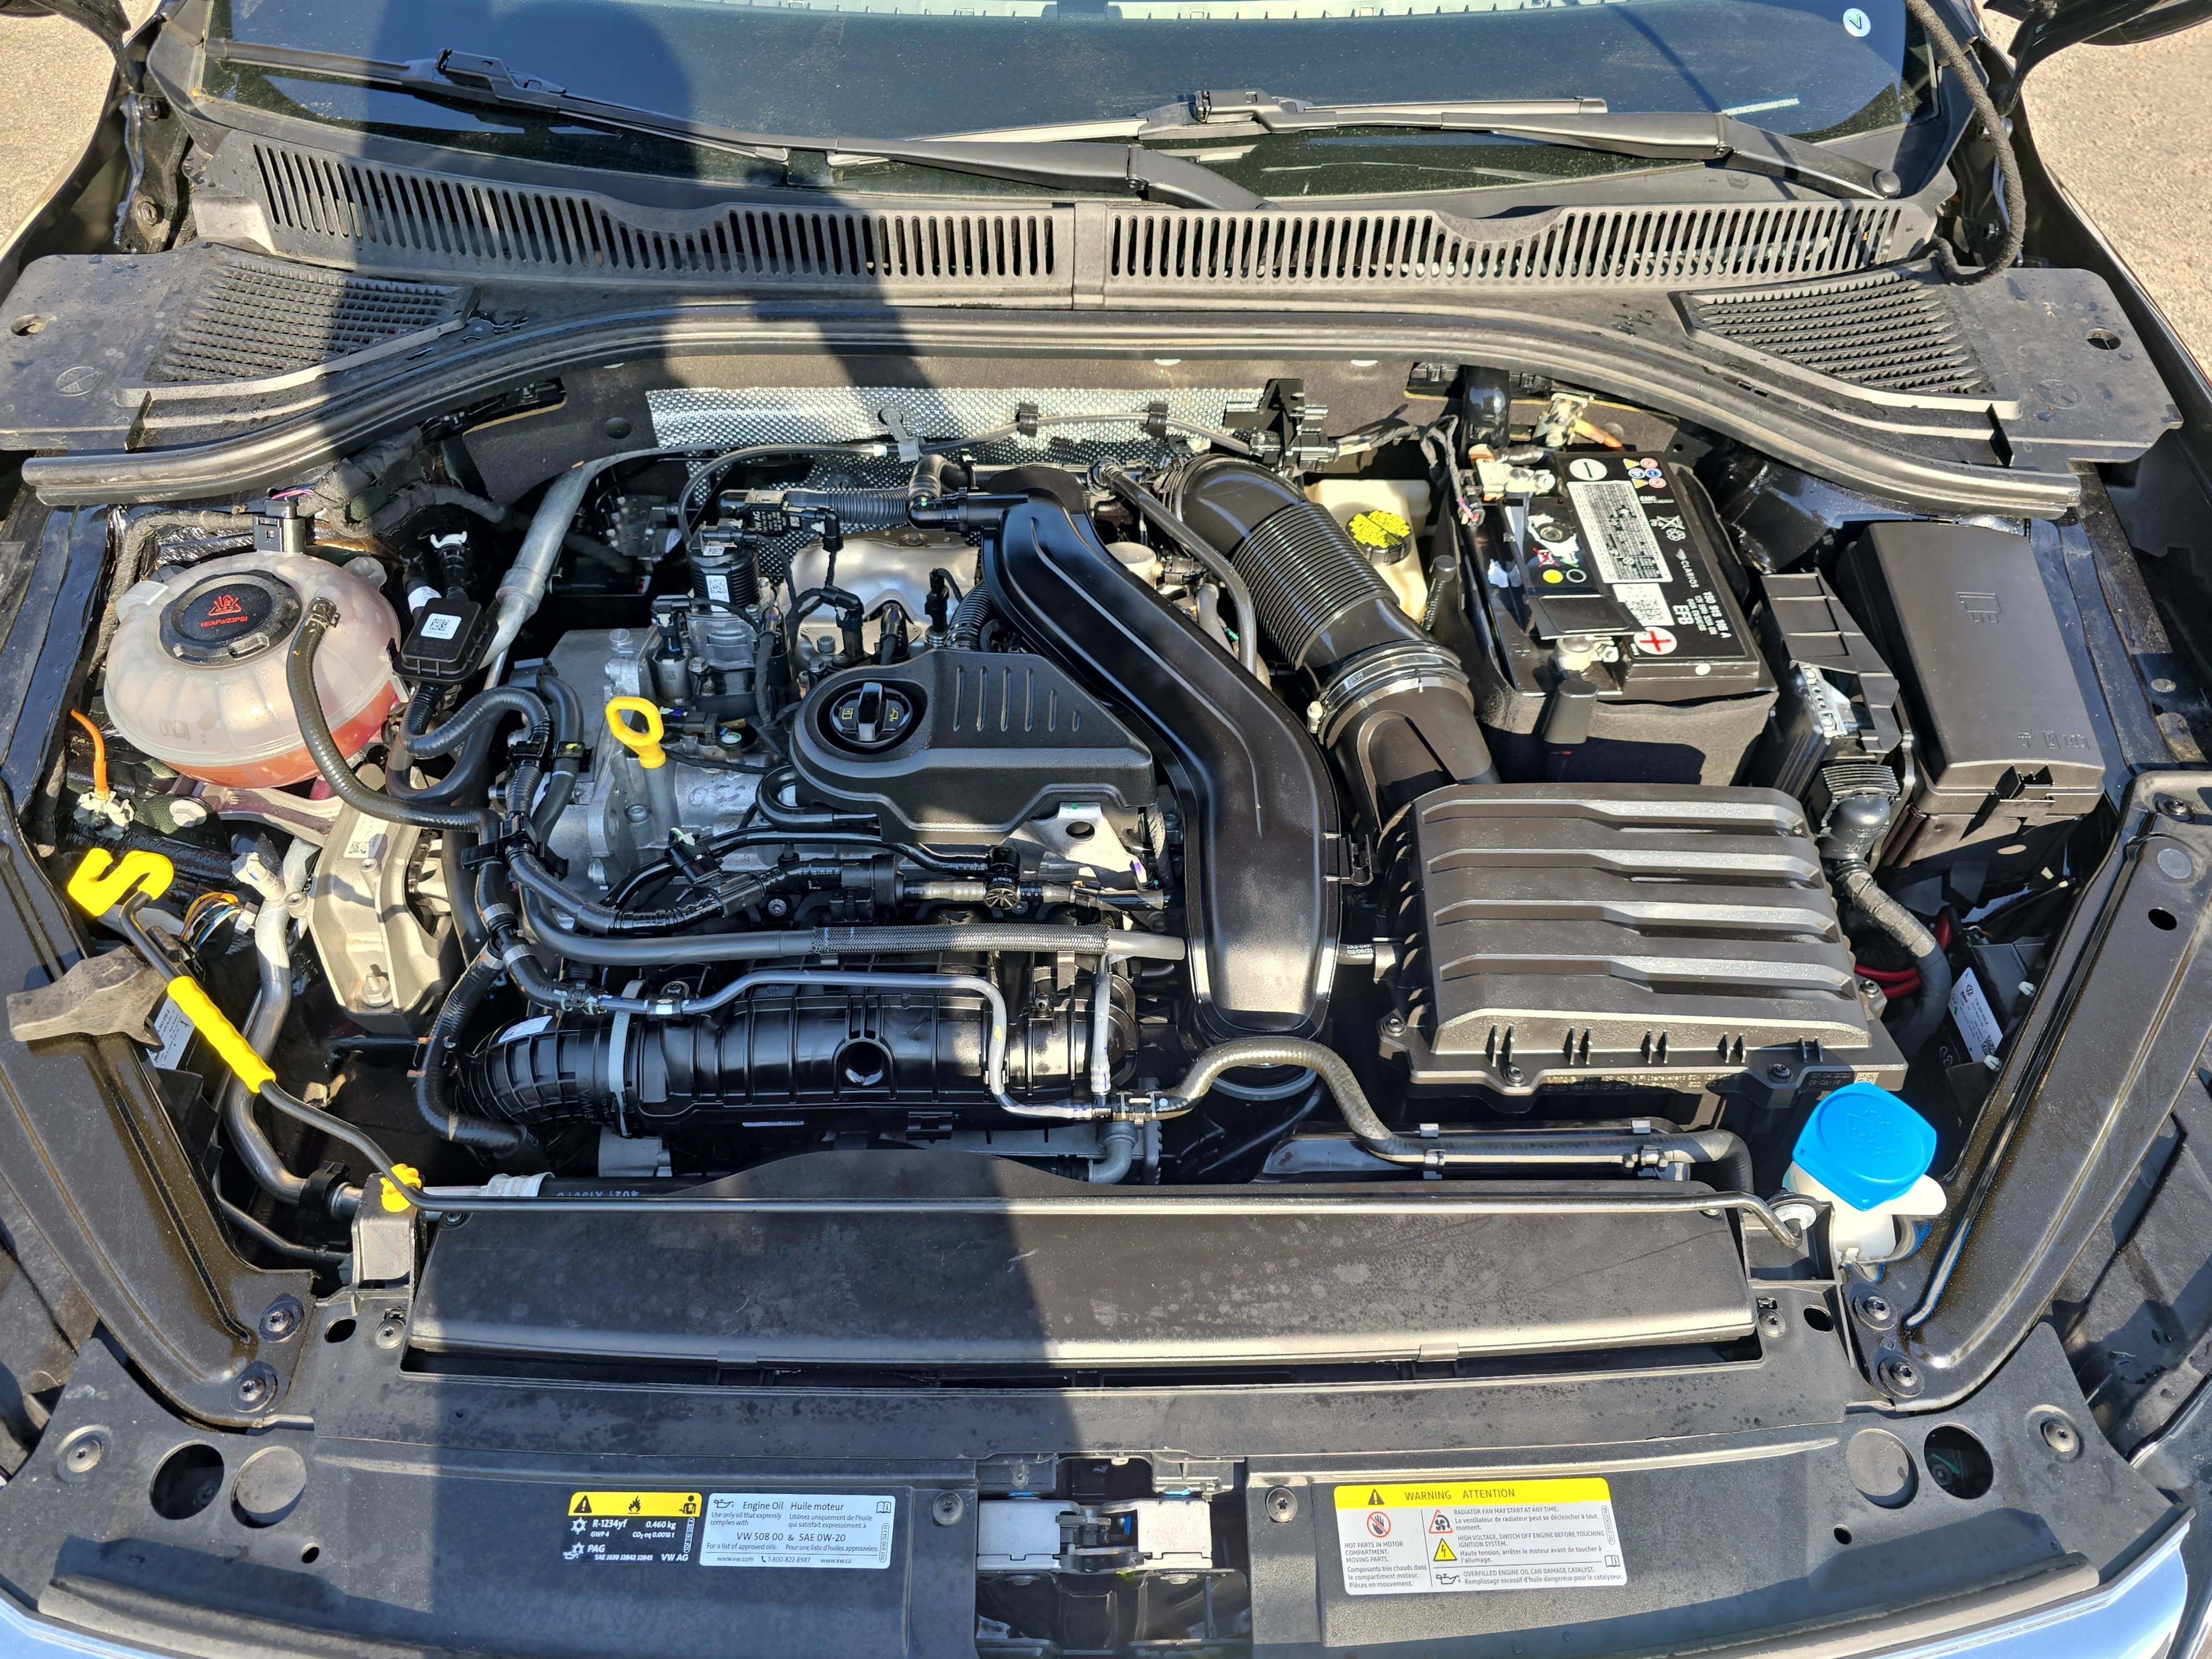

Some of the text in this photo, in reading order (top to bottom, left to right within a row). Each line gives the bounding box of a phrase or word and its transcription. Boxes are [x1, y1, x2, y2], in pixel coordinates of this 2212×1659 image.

[1681, 560, 1699, 588] CLARIOS
[1672, 605, 1694, 625] EFB
[1709, 605, 1722, 616] 915
[1405, 1489, 1515, 1500] WARNING ATTENTION
[743, 1501, 770, 1512] Engine
[790, 1502, 812, 1510] Huile
[592, 1519, 677, 1530] R-1234yf 0.460 kg
[737, 1532, 753, 1540] VW
[754, 1533, 769, 1541] 508
[772, 1533, 783, 1541] 00
[799, 1533, 814, 1541] SAE
[817, 1534, 846, 1542] 0W-20
[587, 1544, 606, 1553] PAG
[1355, 1573, 1396, 1581] compartiment
